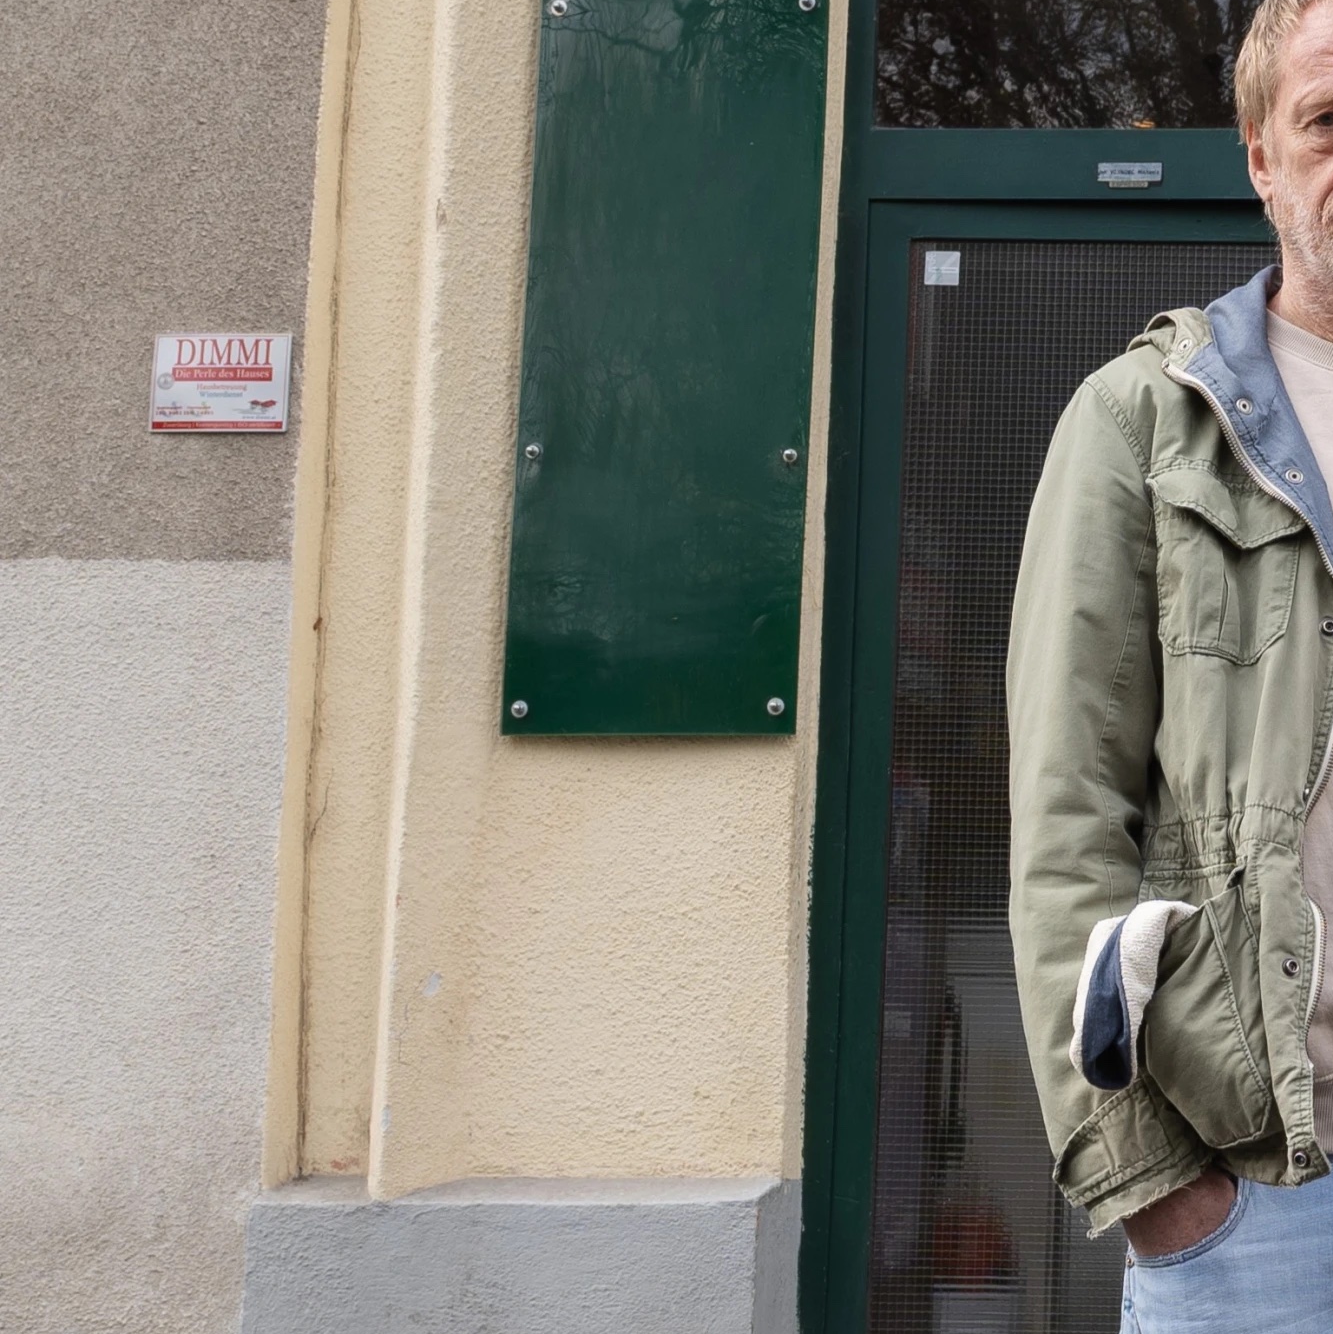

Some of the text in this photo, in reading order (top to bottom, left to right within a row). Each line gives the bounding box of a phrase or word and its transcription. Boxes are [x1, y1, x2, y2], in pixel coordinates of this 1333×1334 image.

[175, 338, 274, 365] DIMMI
[175, 368, 270, 379] Die Perle des Hauses
